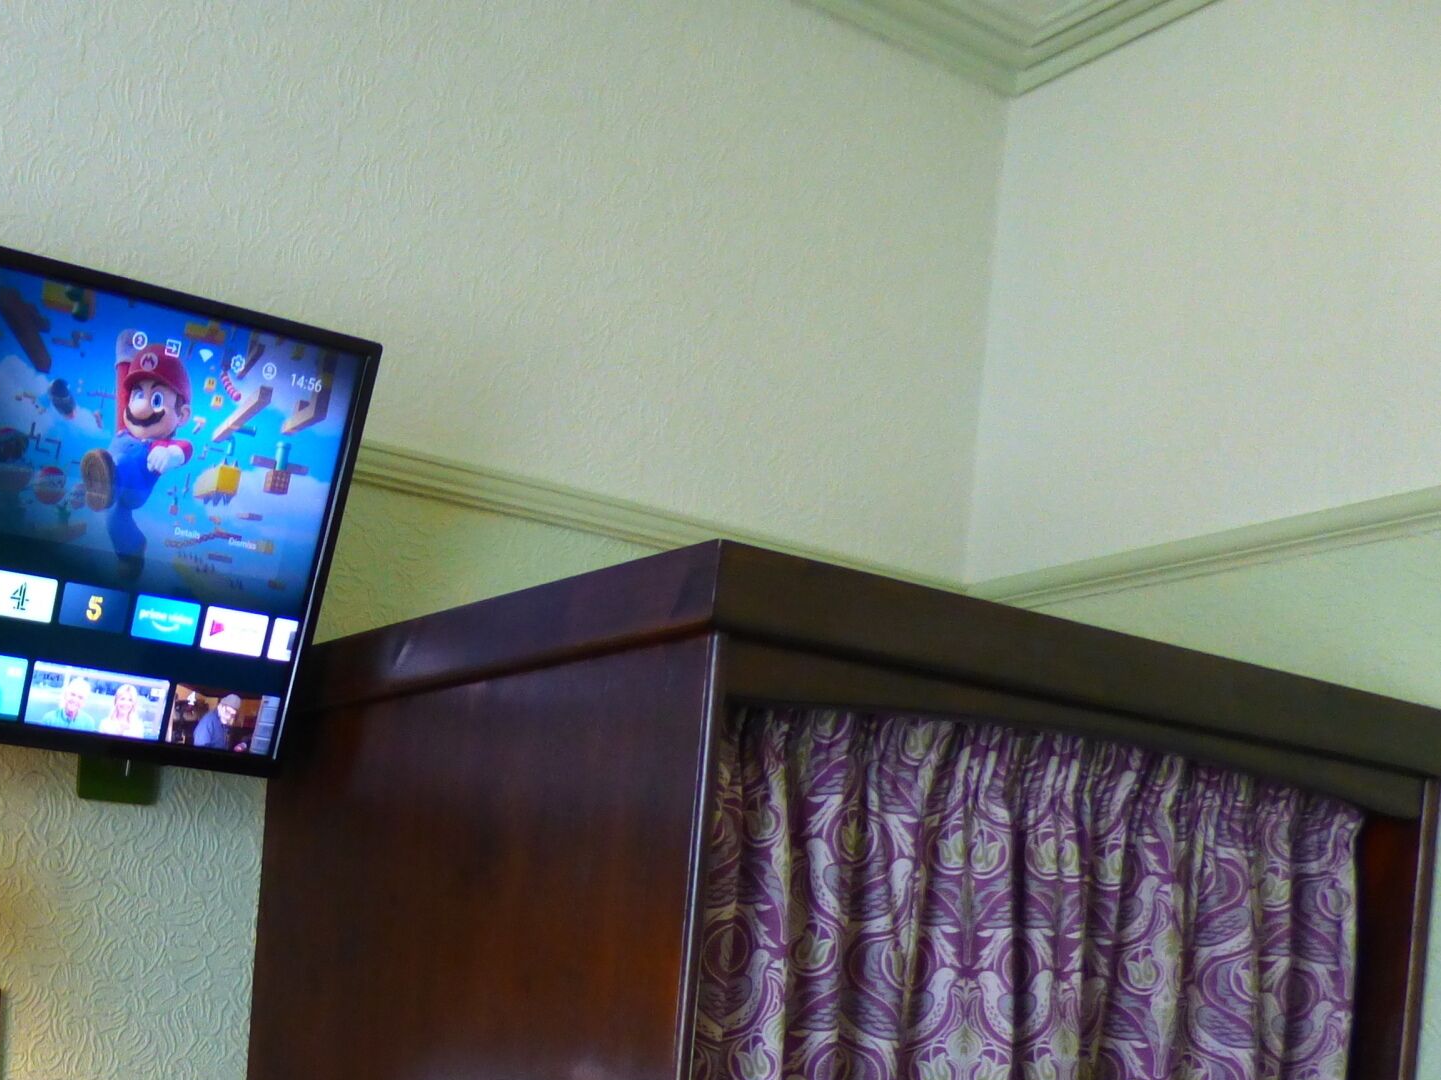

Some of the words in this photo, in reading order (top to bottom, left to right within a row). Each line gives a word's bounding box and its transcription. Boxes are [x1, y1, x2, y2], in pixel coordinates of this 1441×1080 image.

[291, 373, 322, 393] 14:56
[175, 526, 200, 540] Details
[228, 537, 257, 551] Dismiss
[86, 595, 103, 622] 5
